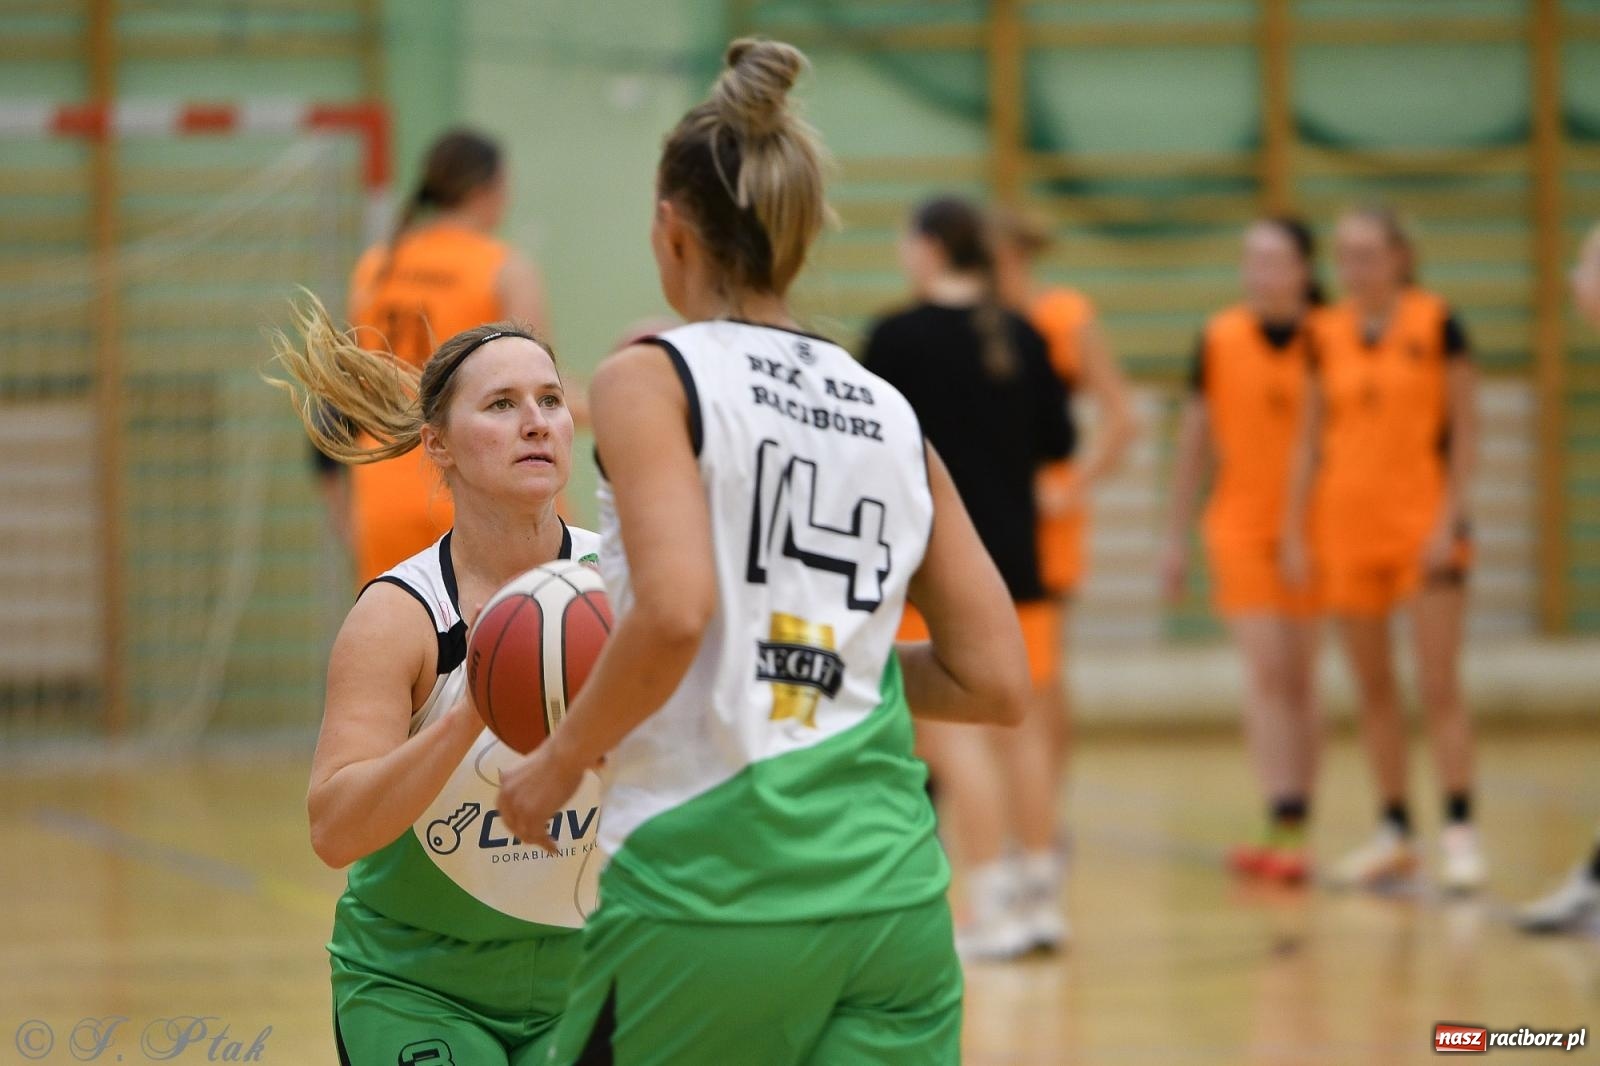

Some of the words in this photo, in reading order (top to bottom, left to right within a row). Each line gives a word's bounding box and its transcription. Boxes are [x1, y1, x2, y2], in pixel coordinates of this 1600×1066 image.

[824, 378, 875, 404] AZS
[746, 439, 891, 613] 14
[491, 846, 577, 864] DORABIANIE
